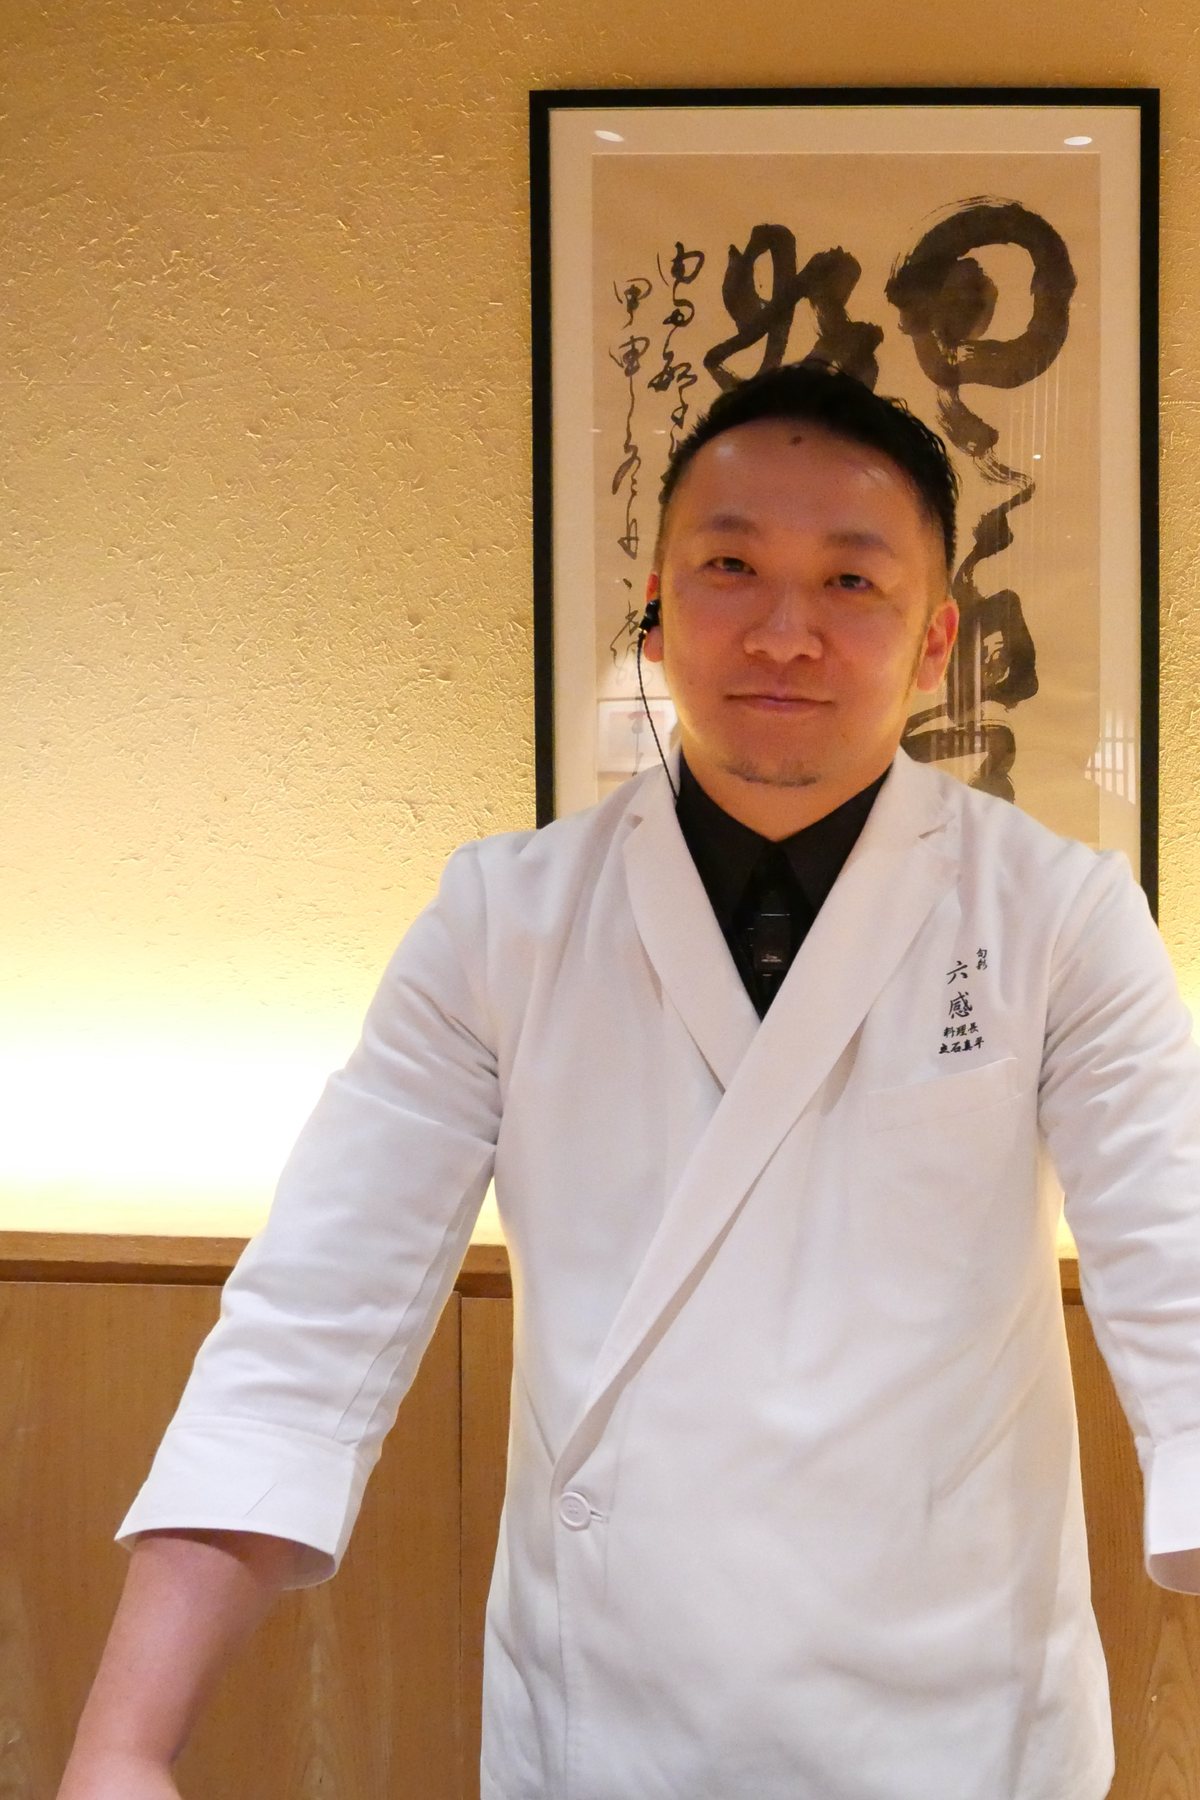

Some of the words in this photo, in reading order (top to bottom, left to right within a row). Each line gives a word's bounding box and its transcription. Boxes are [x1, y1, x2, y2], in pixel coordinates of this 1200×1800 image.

[945, 960, 973, 1019] 六感
[943, 1021, 980, 1039] 料理長
